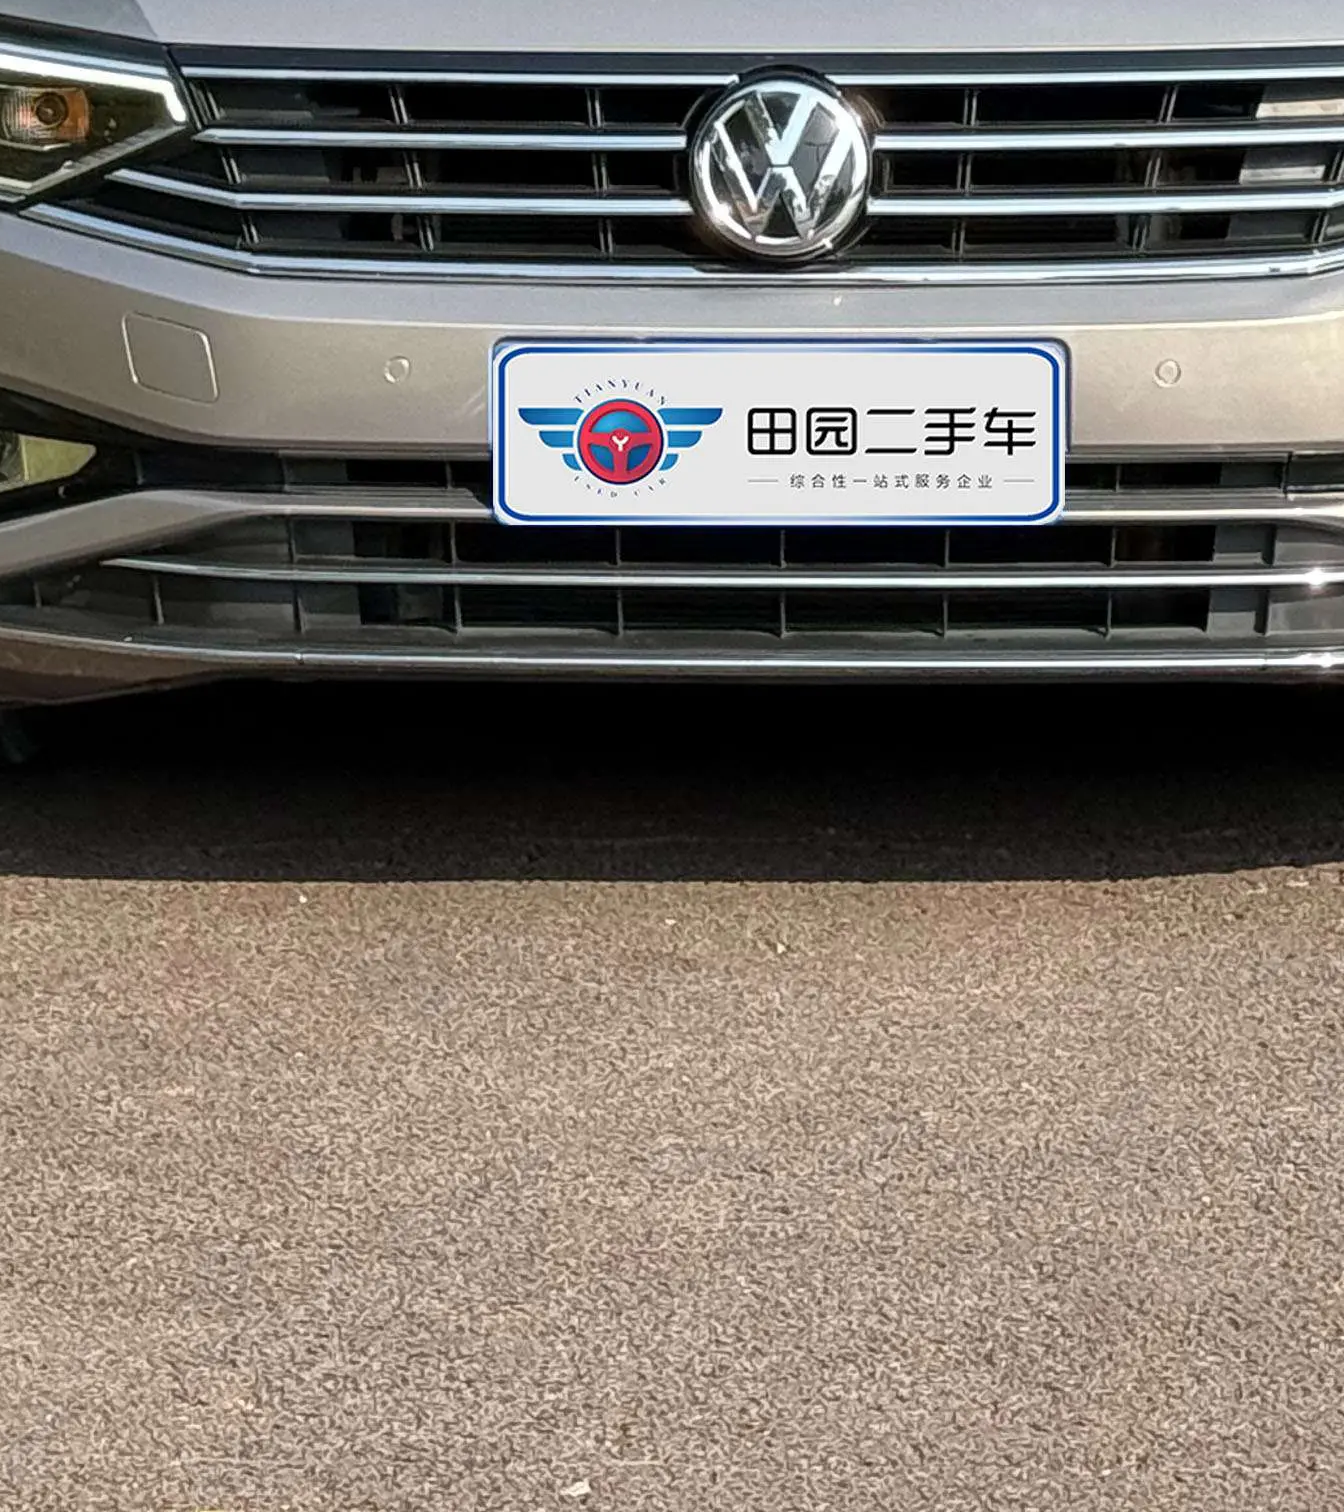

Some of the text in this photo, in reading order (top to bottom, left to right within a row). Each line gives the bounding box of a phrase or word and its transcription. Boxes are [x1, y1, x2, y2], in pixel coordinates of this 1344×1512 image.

[702, 85, 863, 245] VW
[747, 406, 1037, 456] 田园二手车
[789, 473, 993, 489] 综合性一站式服务企业
